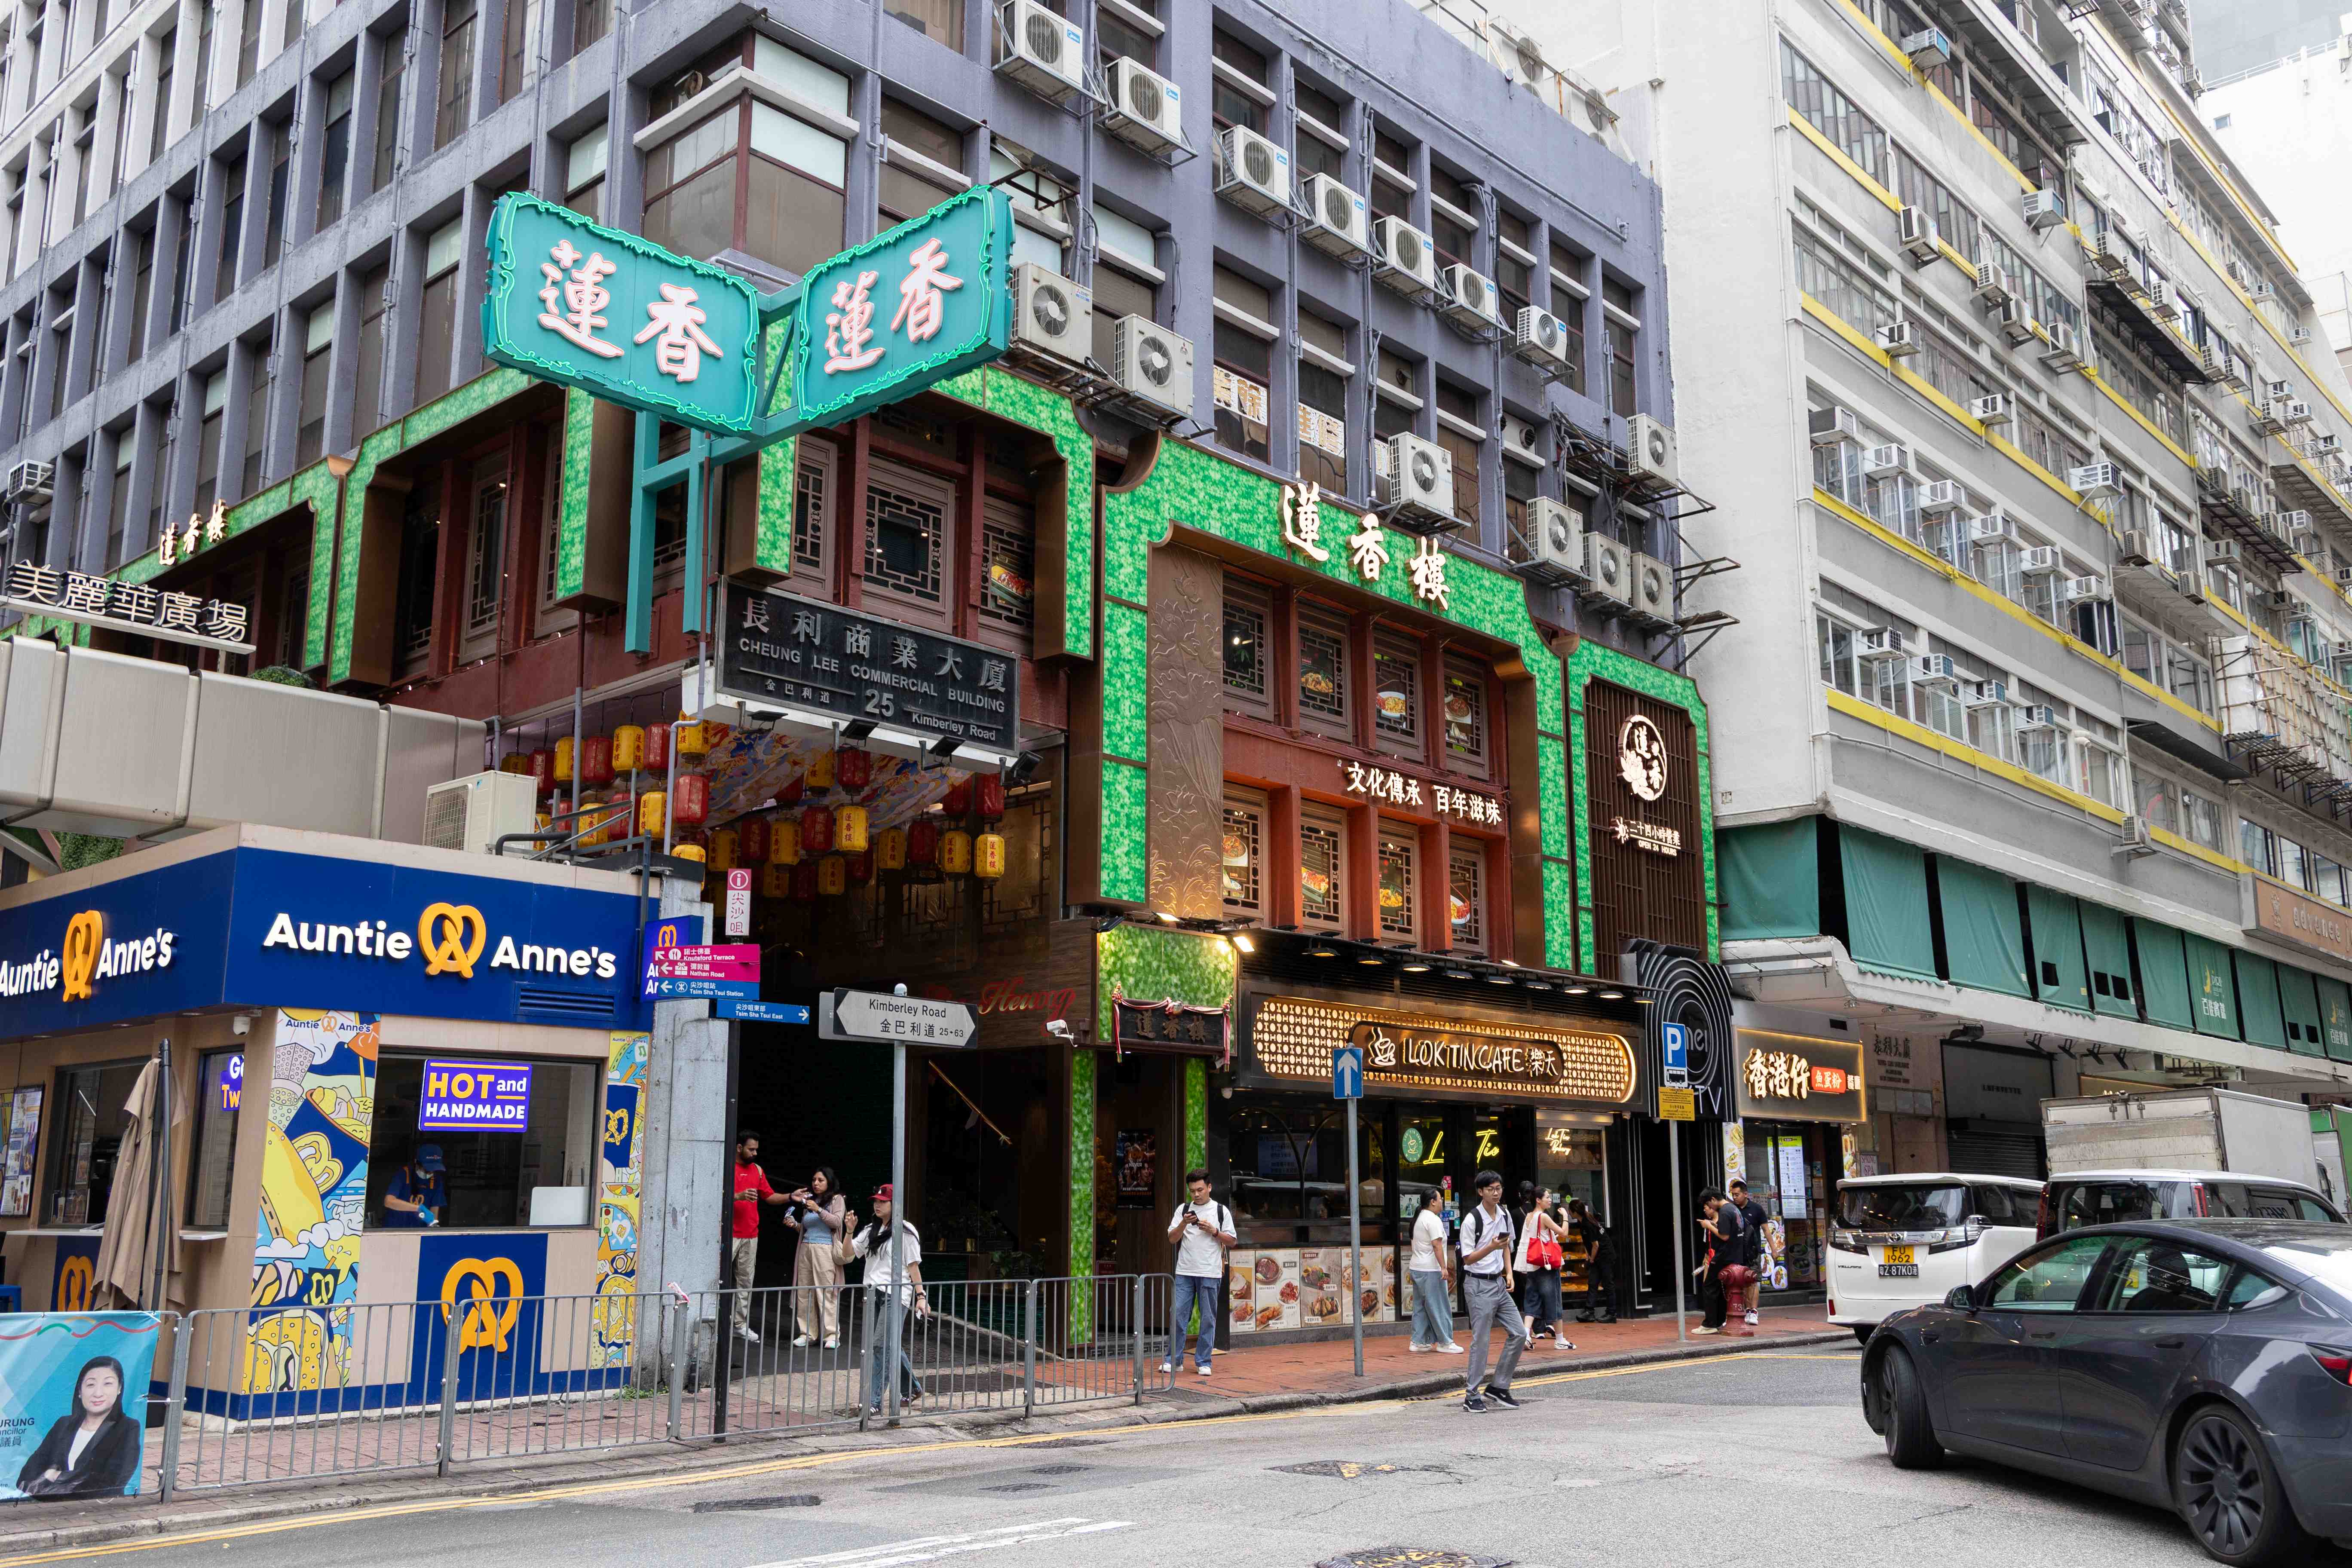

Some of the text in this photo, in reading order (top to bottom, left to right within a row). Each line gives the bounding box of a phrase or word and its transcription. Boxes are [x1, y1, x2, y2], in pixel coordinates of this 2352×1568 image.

[537, 239, 724, 383] 蓮香
[824, 237, 965, 376] 蓮香
[159, 499, 228, 566] 蓮香樓
[1280, 481, 1451, 611] 蓮香樓
[9, 558, 248, 642] 美麗華廣場
[743, 597, 1007, 693] 長利商業大廈
[740, 638, 1005, 713] CHEUNG LEE COMMERCIAL BUILDING
[765, 678, 830, 704] 金巴利道
[865, 689, 895, 717] 25
[912, 712, 996, 741] Kimberley Road
[1346, 762, 1503, 825] 文化傳承 百年滋味
[1629, 820, 1681, 847] 二十四小時營業
[1638, 840, 1677, 856] OPEN 24 HOURS
[730, 892, 744, 934] 尖沙咀
[0, 927, 173, 997] Auntie Anne's
[263, 913, 412, 960] Auntie
[490, 936, 617, 979] Anne's
[286, 1019, 371, 1032] Auntie Anne's
[869, 998, 946, 1018] Kimberley Road
[880, 1018, 935, 1038] 金巴利道
[1135, 1009, 1206, 1044] 蓮香樓
[1528, 1048, 1559, 1077] 樂天
[1667, 1027, 1681, 1064] P
[428, 1072, 526, 1100] HOT and
[1744, 1048, 1810, 1099] 香港仔
[1815, 1070, 1842, 1089] 魚蛋粉
[1847, 1074, 1861, 1090] 餐廳
[425, 1102, 525, 1120] HANDMADE
[1887, 1255, 1910, 1263] 1962
[1892, 1246, 1906, 1254] FU
